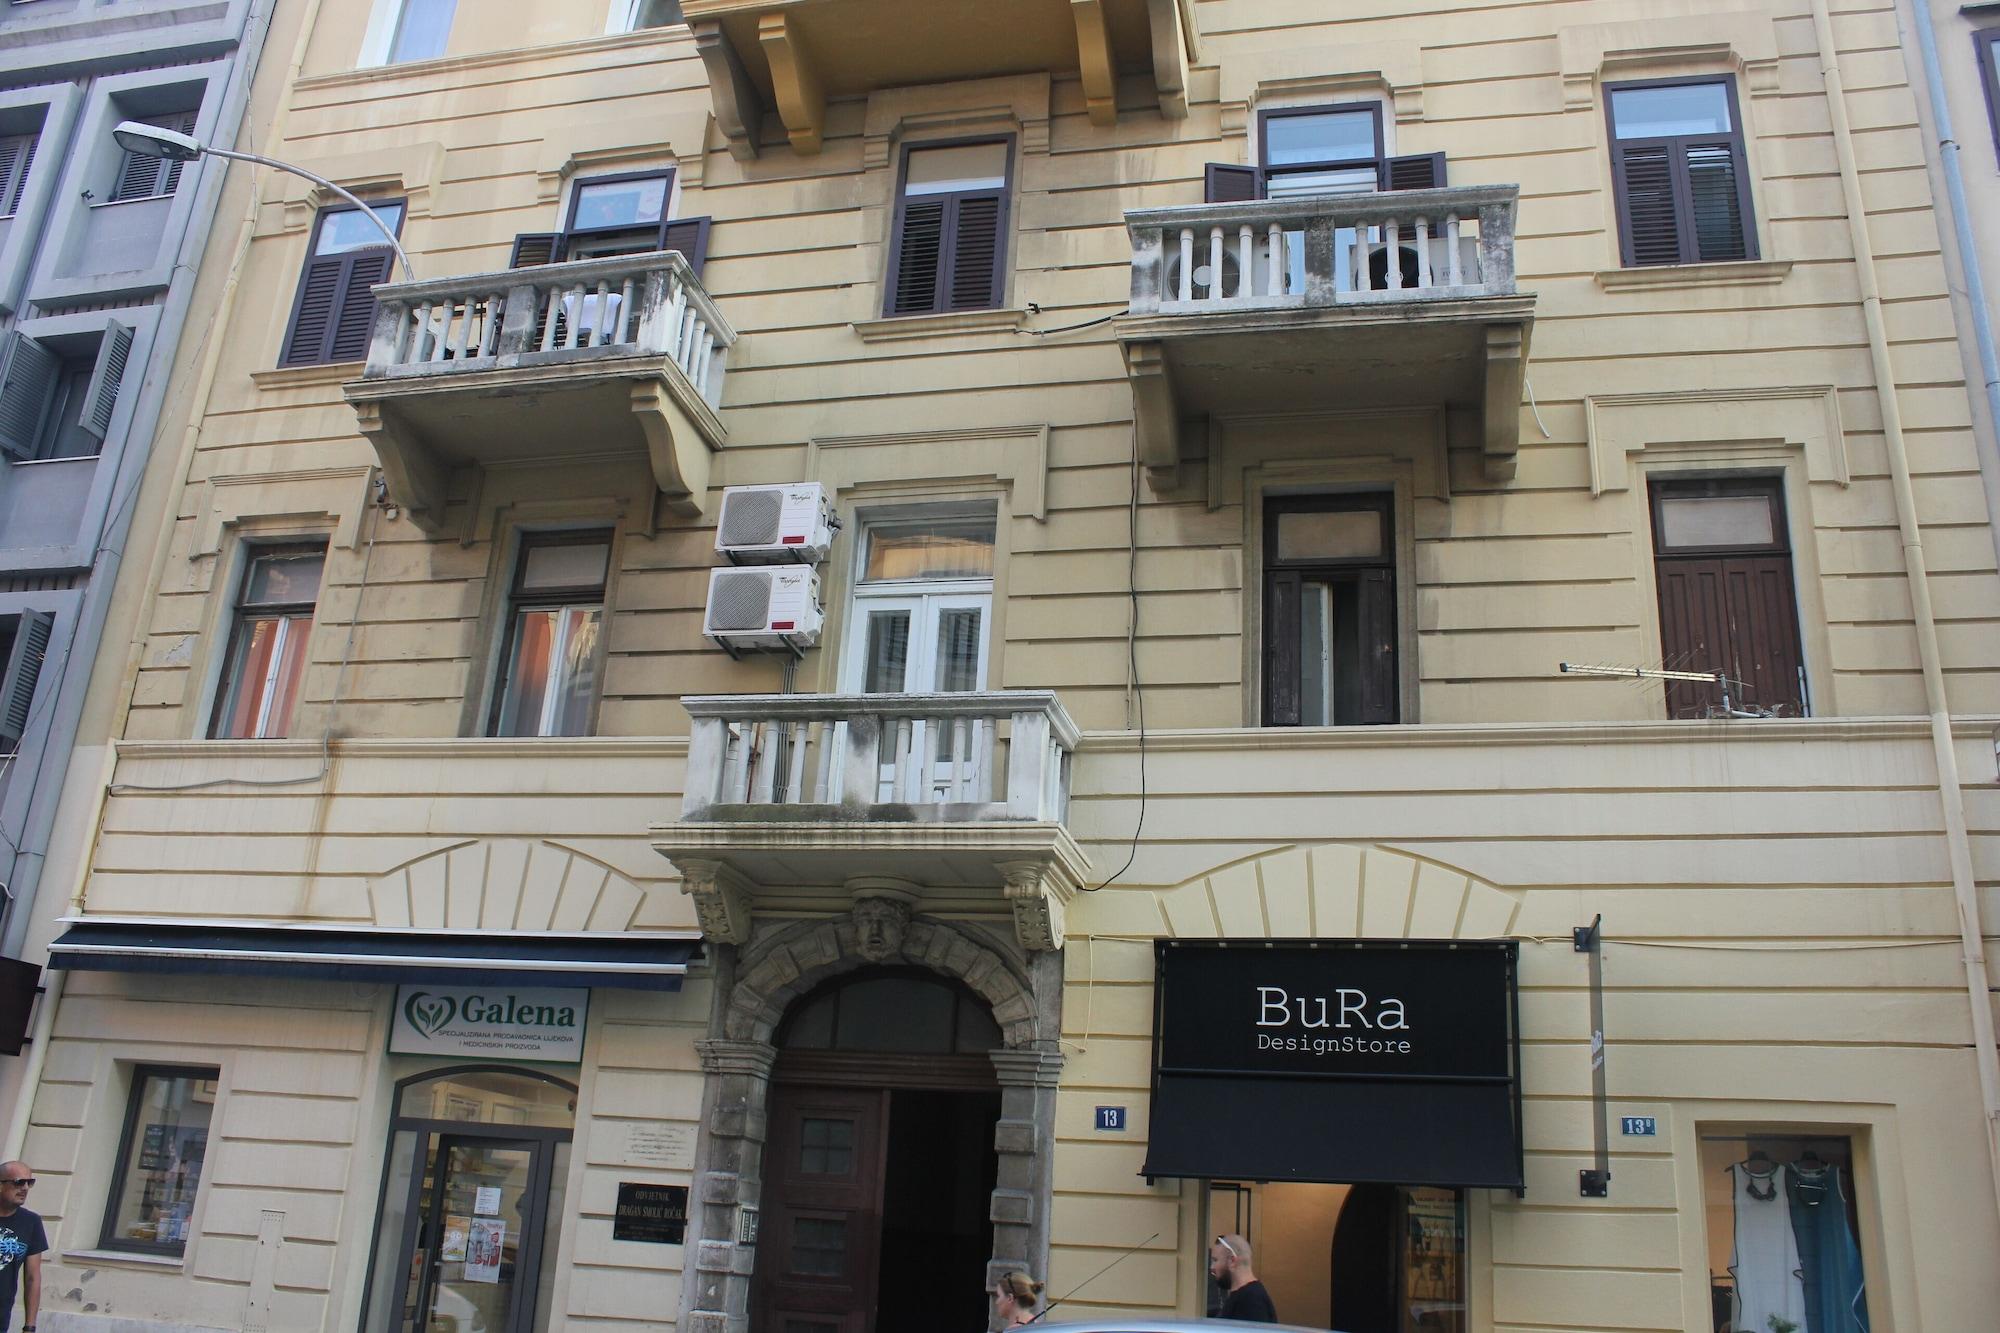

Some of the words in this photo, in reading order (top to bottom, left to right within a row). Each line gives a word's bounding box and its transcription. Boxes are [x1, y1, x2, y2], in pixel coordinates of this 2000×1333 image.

[461, 995, 575, 1027] Galena
[1256, 987, 1410, 1030] BuRa
[1257, 1034, 1411, 1056] DesignStore
[1103, 1109, 1117, 1127] 13
